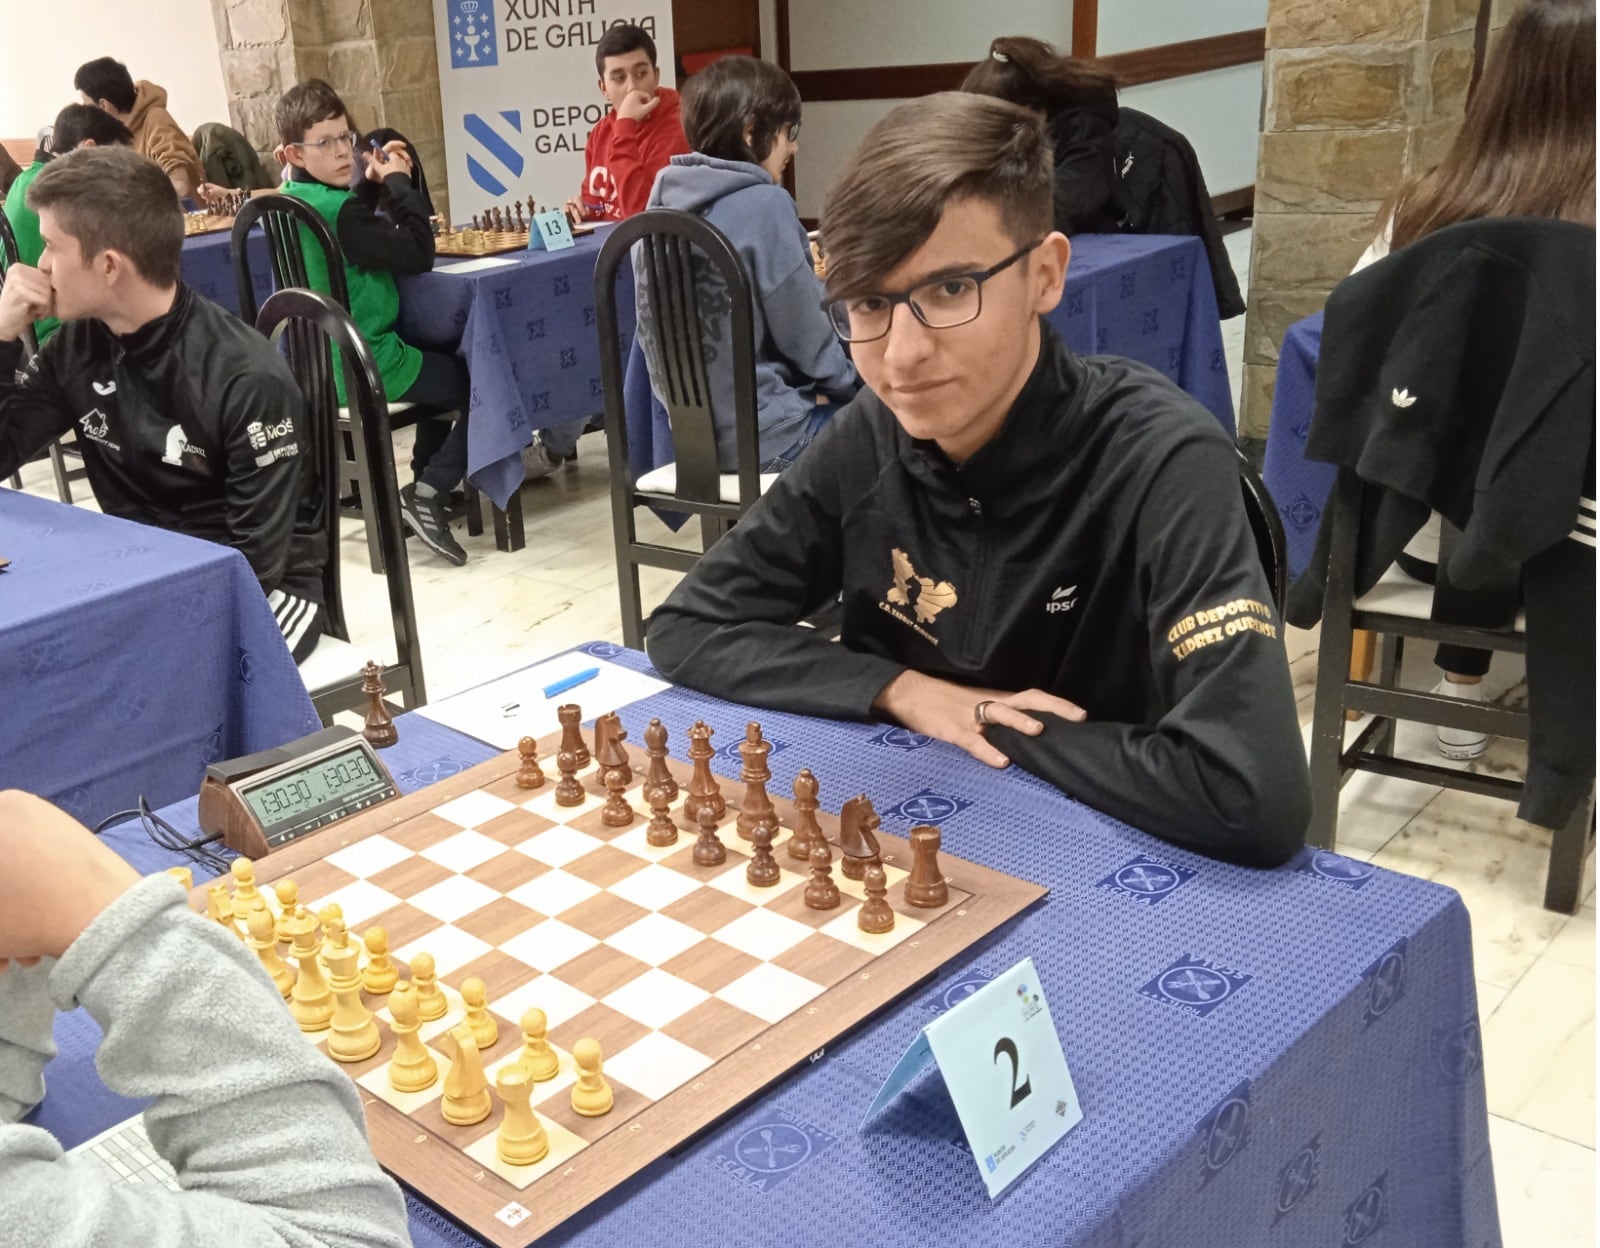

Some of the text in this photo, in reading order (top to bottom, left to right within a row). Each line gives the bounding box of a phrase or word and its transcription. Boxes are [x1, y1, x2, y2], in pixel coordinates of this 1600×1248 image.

[505, 26, 538, 52] DE
[535, 131, 592, 154] GAL
[545, 219, 562, 236] 13
[1168, 616, 1196, 643] CLUB
[993, 1037, 1032, 1110] 2
